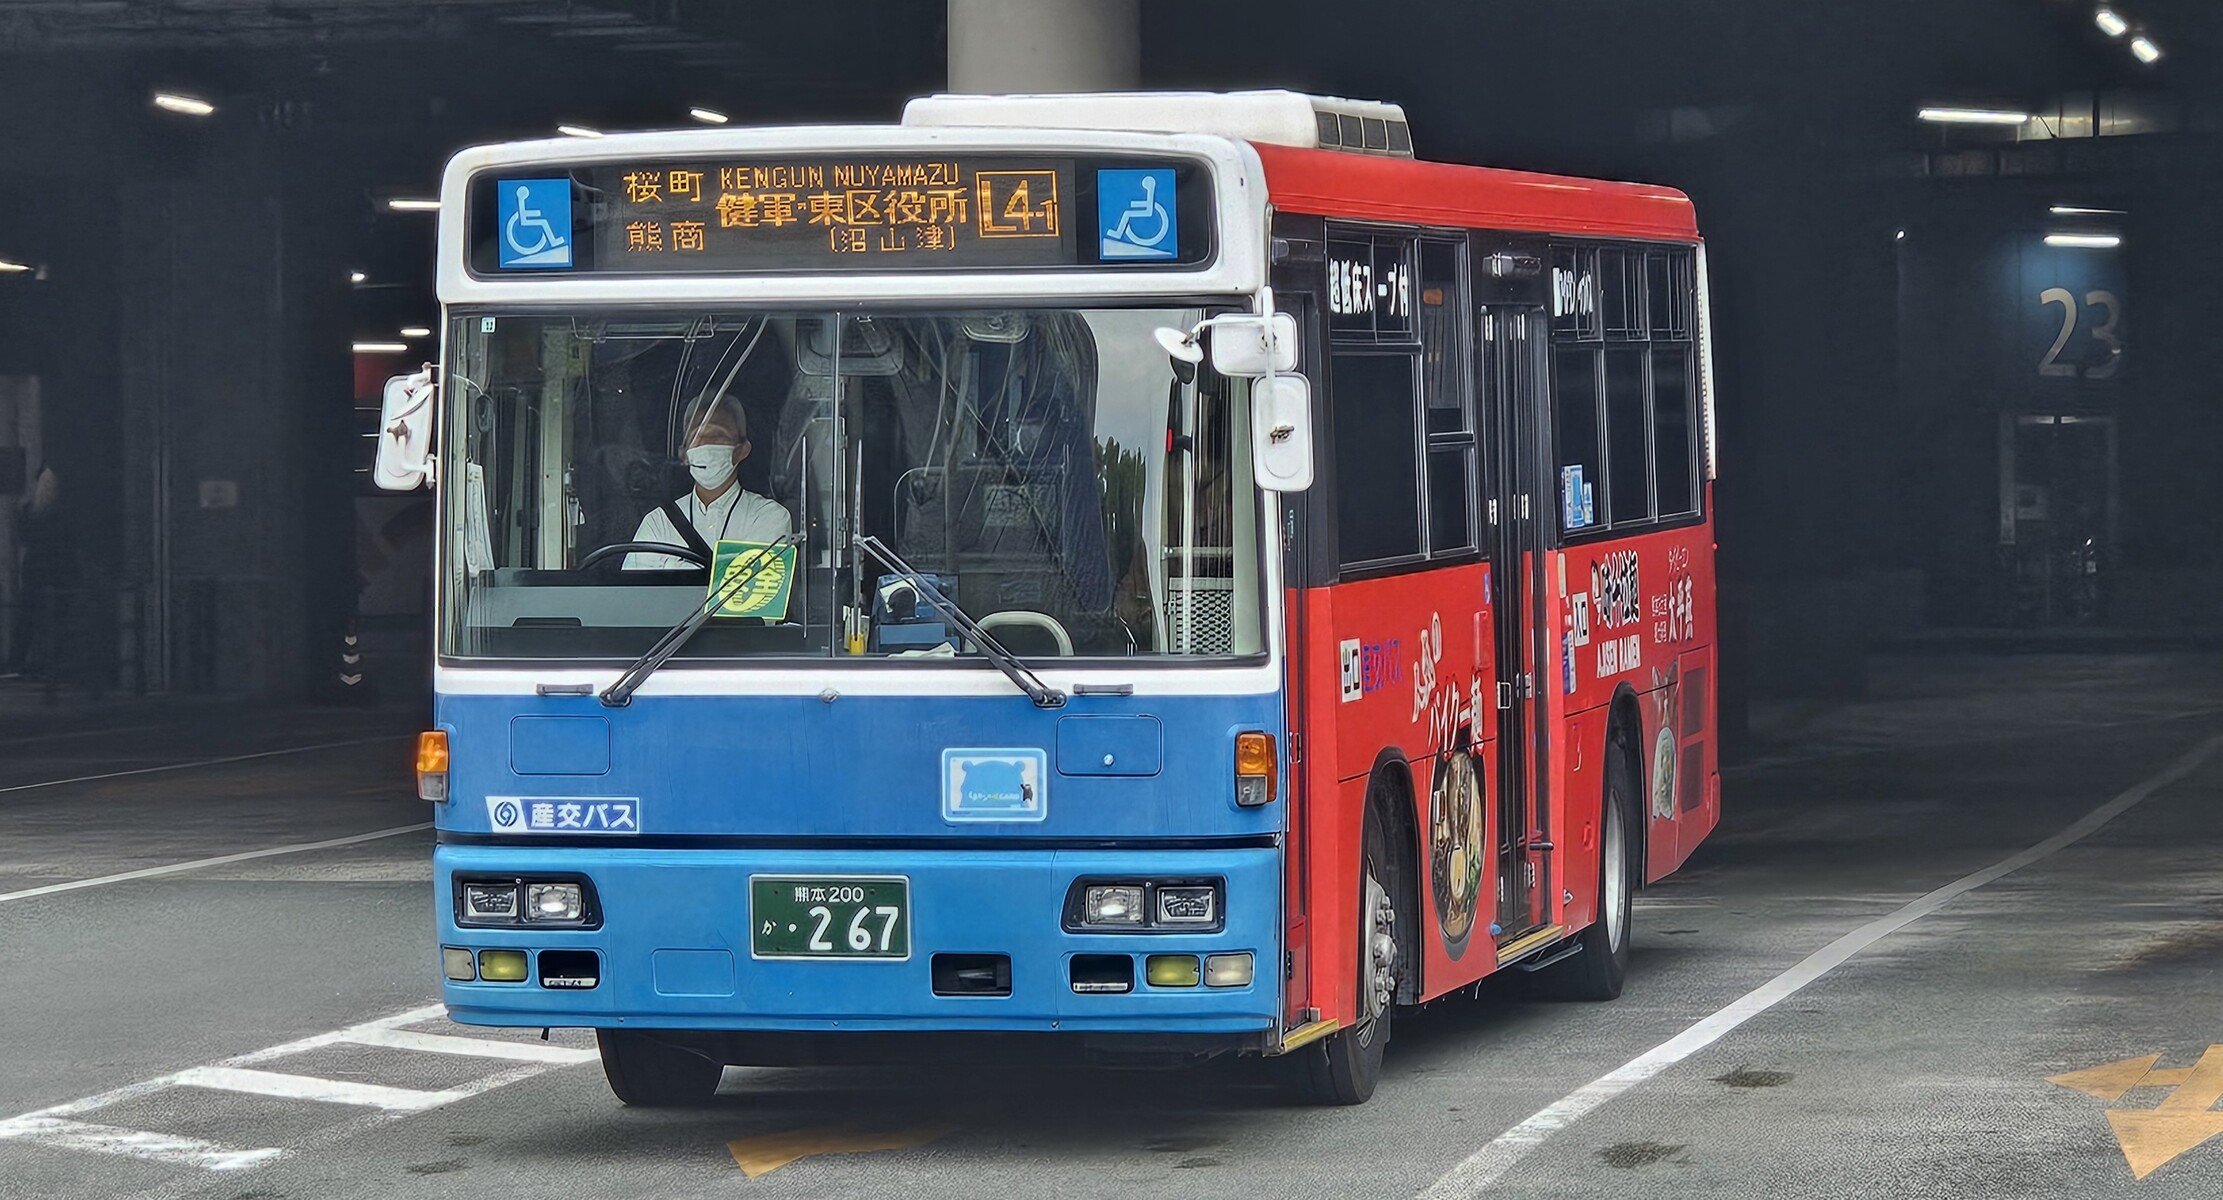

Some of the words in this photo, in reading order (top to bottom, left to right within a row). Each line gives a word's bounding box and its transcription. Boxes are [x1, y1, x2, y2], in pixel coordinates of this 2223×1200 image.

[622, 168, 704, 203] 桜町
[720, 165, 824, 190] KENGUN
[833, 162, 960, 188] NUYAMAZU
[625, 220, 705, 252] 熊商
[2038, 286, 2122, 378] 23
[530, 802, 636, 829] 産交バス
